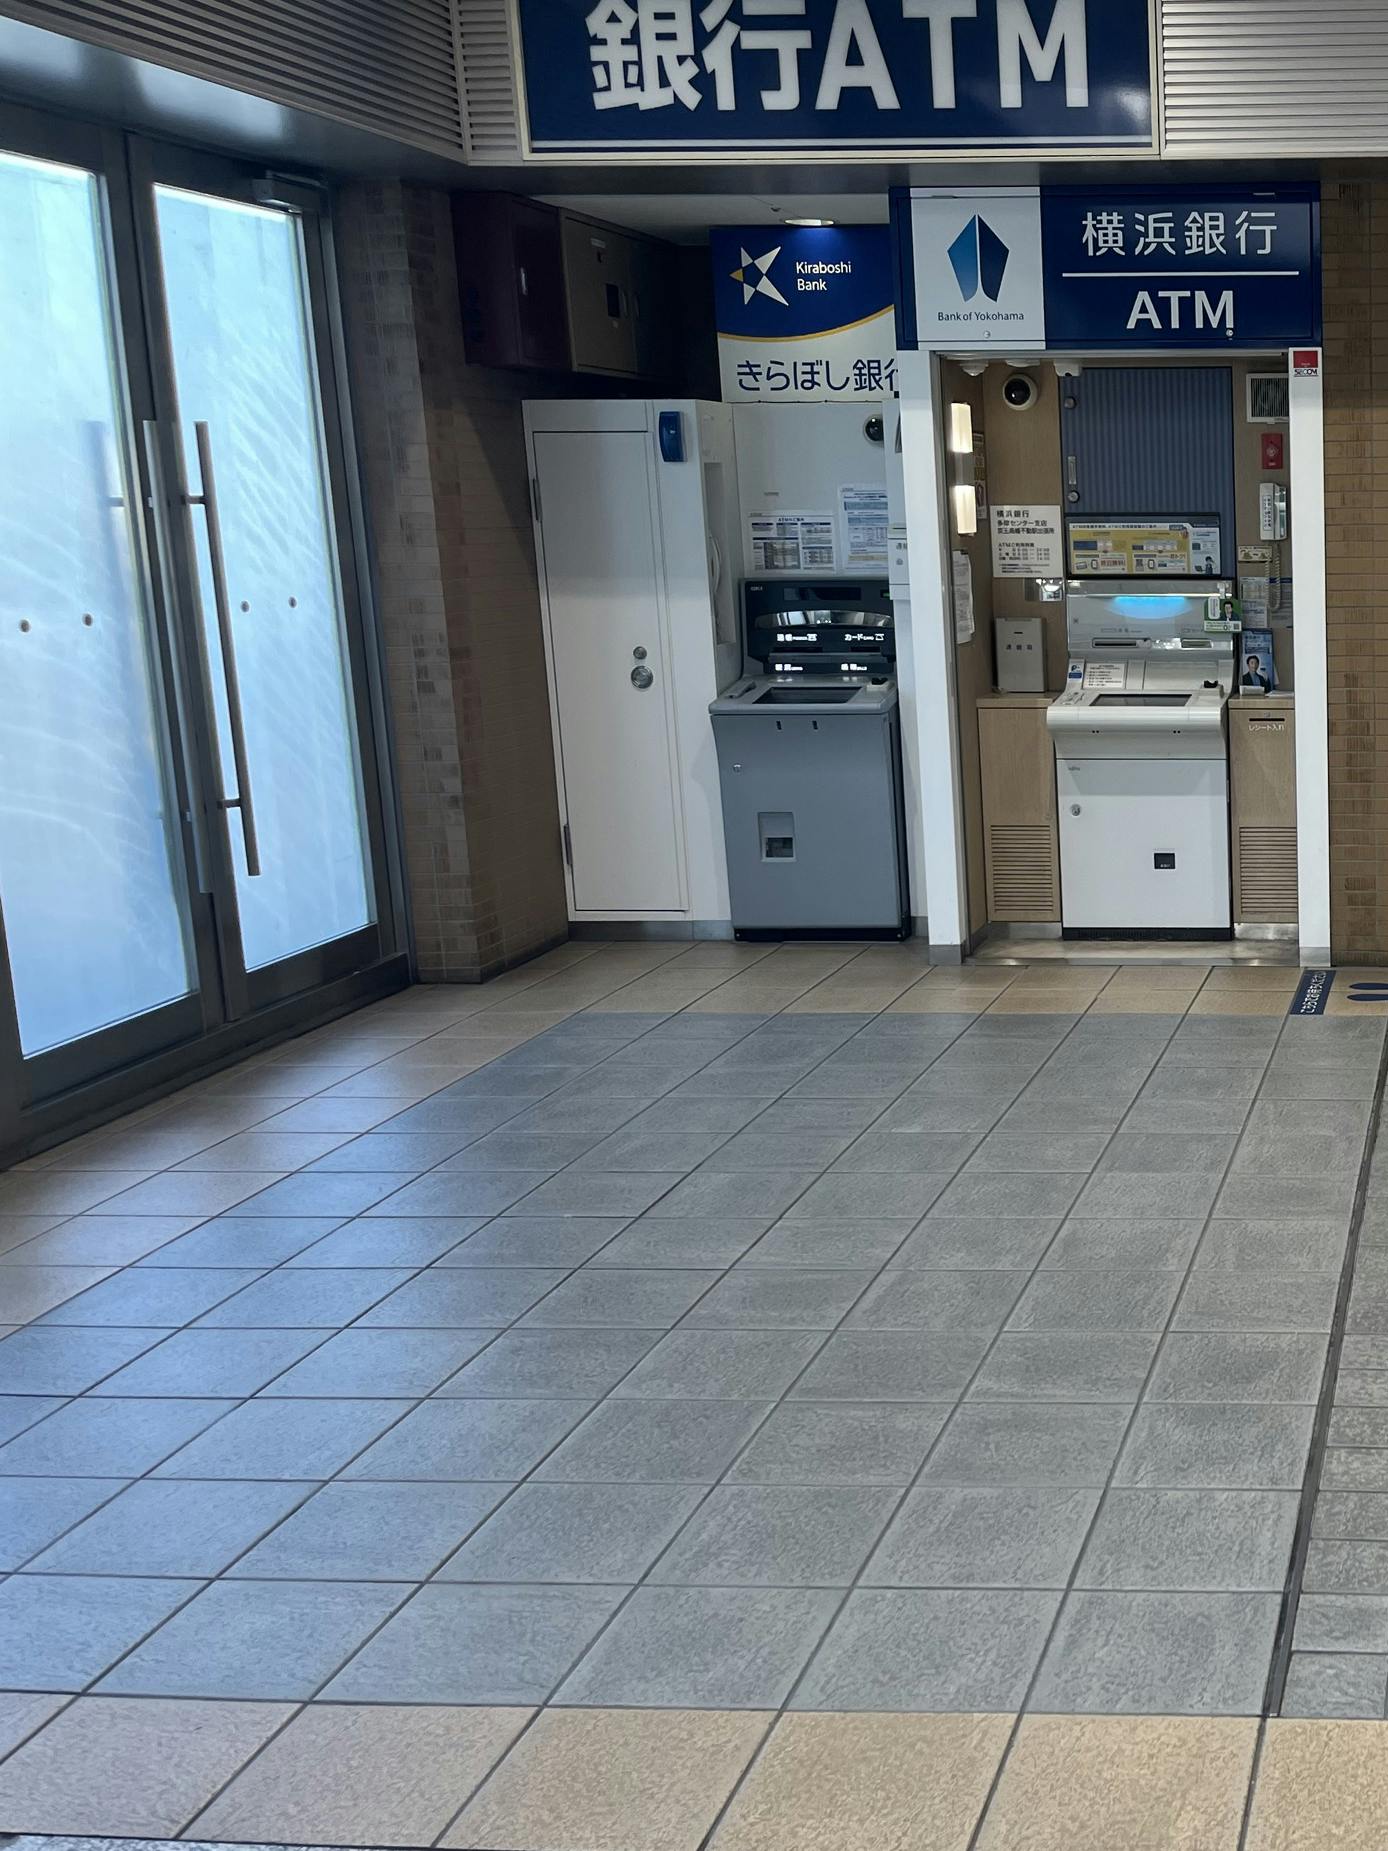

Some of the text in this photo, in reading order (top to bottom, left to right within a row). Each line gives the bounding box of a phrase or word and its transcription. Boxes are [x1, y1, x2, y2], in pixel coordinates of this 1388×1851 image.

[586, 0, 1090, 112] 銀行ATM
[1081, 210, 1278, 257] 横浜銀行
[795, 260, 852, 275] Kiraboshi
[797, 278, 828, 291] Bank
[937, 311, 1025, 322] Bank of Yokohama
[1125, 290, 1235, 330] ATM
